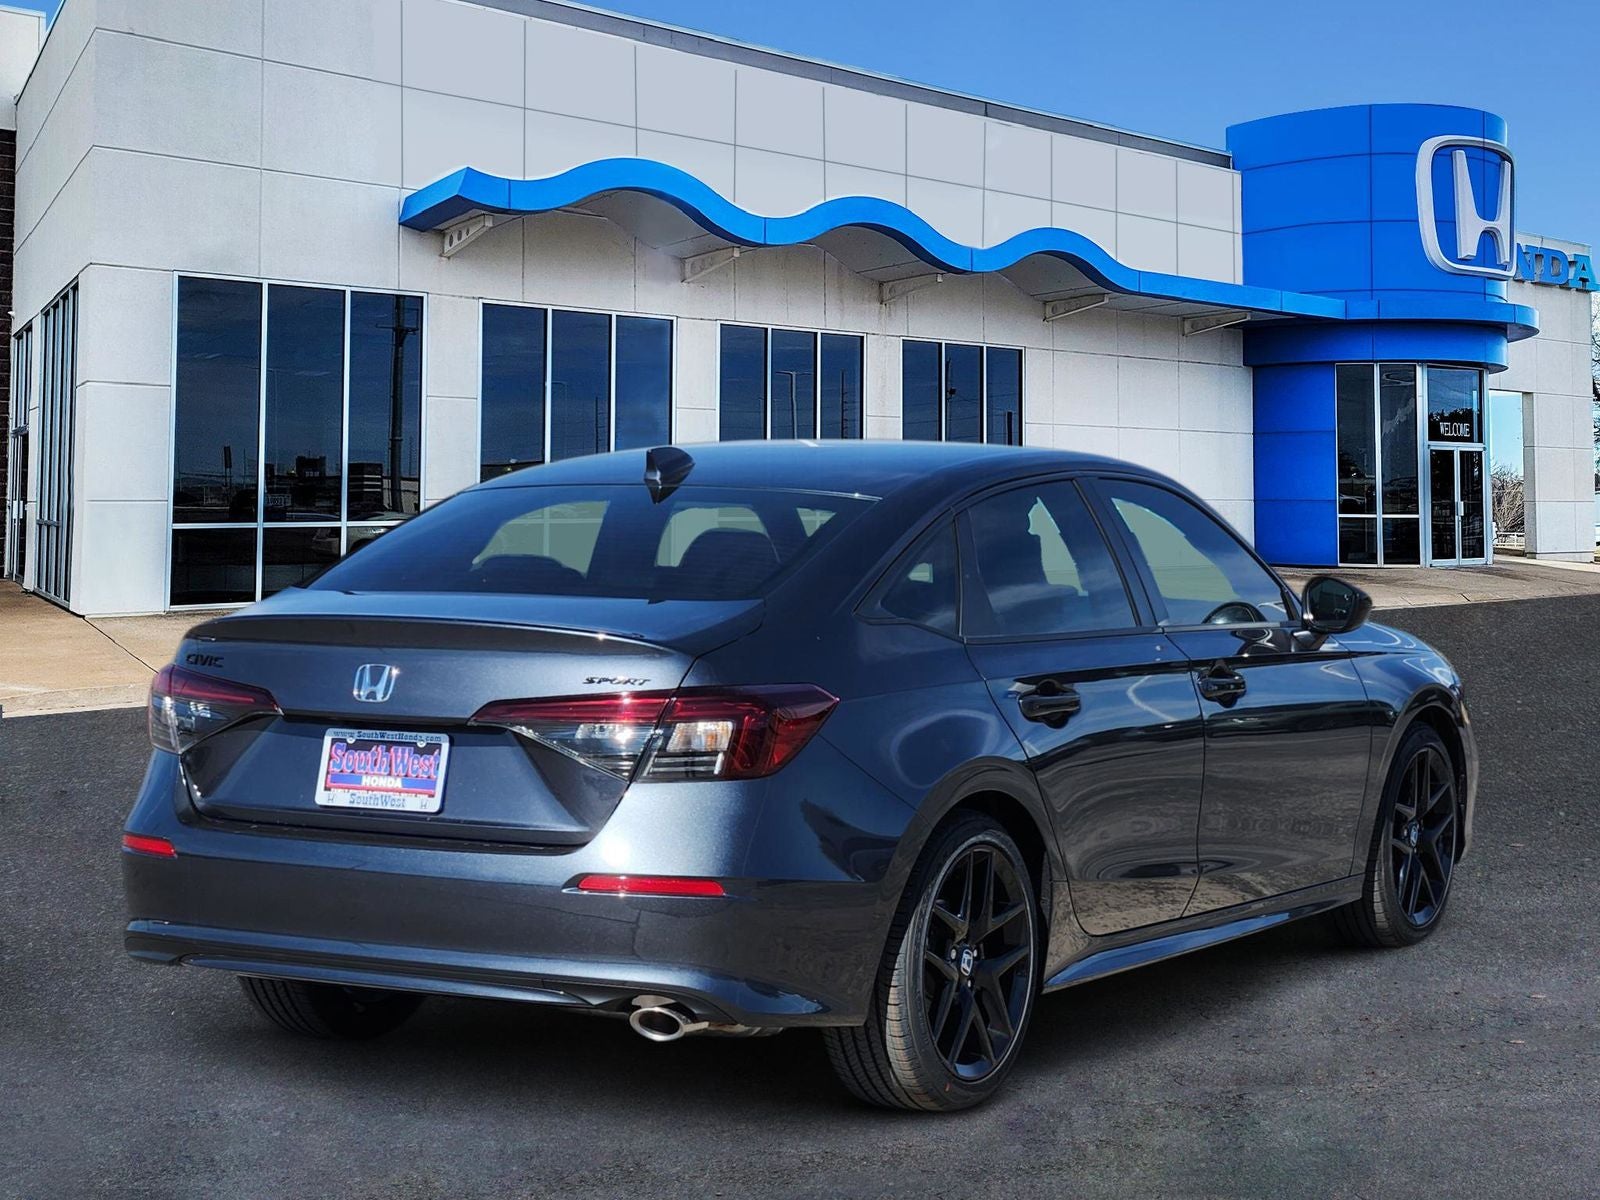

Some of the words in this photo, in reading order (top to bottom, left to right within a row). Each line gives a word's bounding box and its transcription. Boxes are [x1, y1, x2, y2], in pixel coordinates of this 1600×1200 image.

[1440, 422, 1470, 437] WELCOME
[186, 654, 224, 668] CIVIC
[582, 677, 651, 686] SPORT
[361, 775, 403, 788] HONDA
[348, 793, 407, 808] SouthWest
